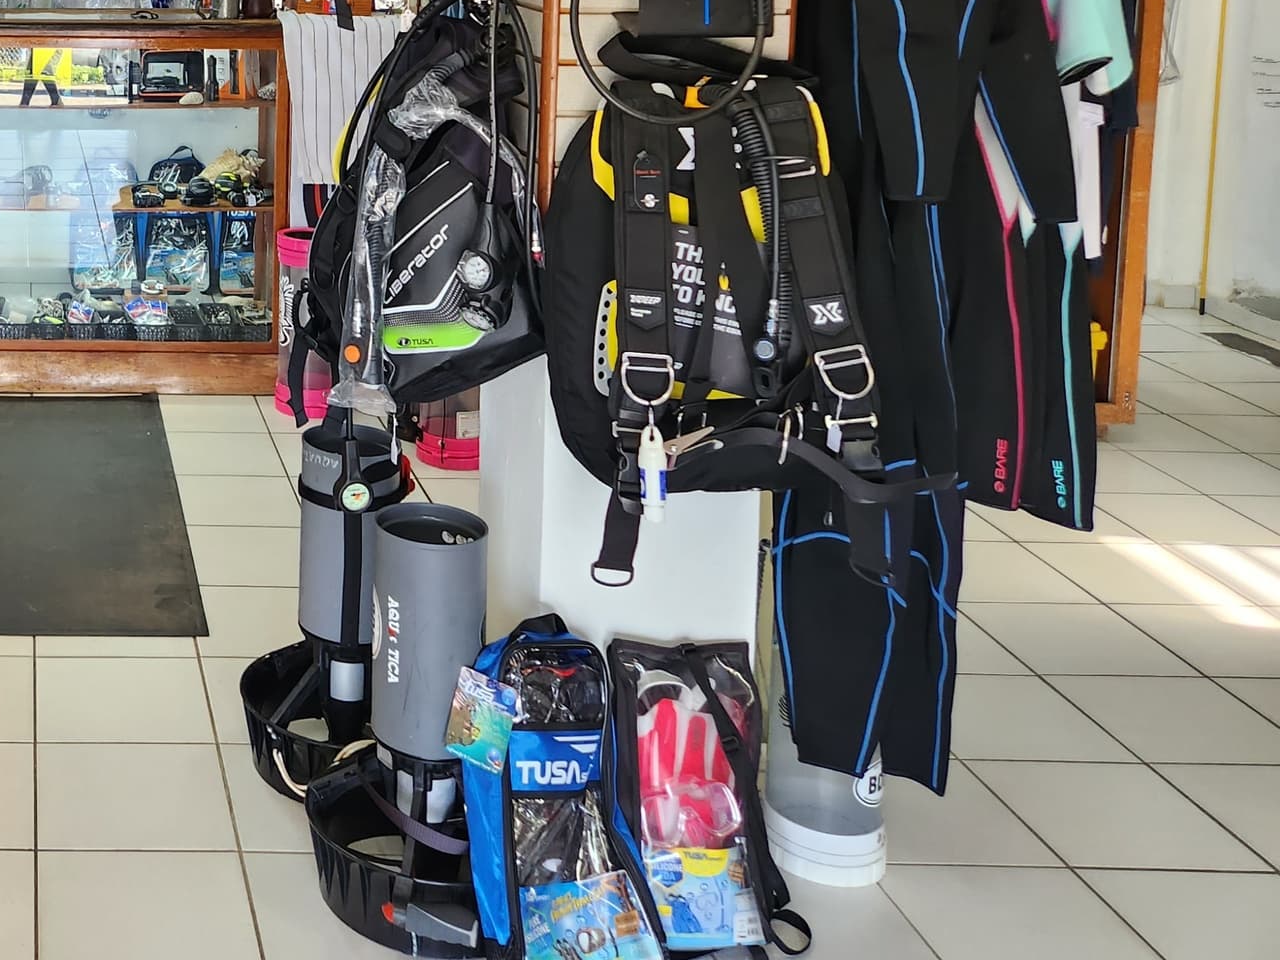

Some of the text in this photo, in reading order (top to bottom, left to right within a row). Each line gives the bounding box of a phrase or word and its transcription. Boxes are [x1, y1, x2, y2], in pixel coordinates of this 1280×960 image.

[994, 438, 1009, 480] BARE
[1051, 459, 1067, 496] BARE
[516, 760, 581, 785] TUSA
